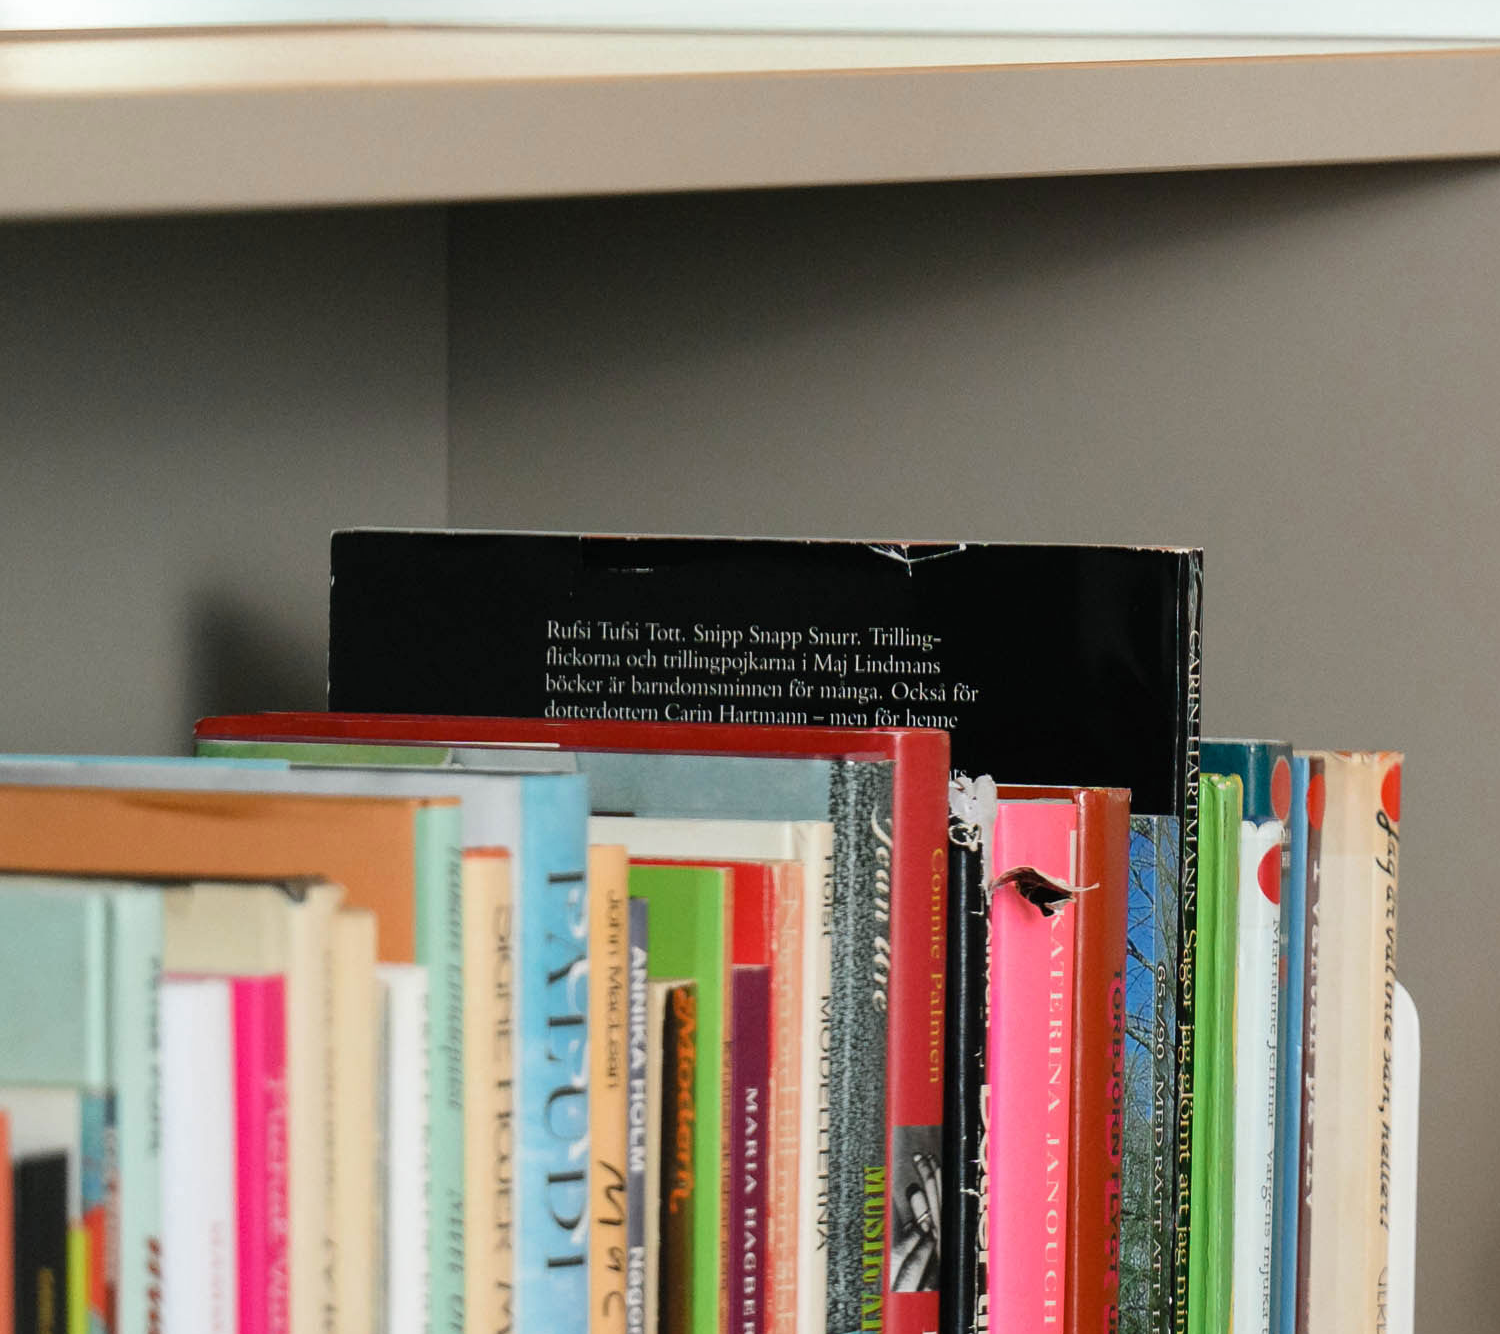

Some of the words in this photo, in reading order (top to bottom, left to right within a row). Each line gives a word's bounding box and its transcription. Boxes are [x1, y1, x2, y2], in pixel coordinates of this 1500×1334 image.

[546, 646, 621, 668] flickorna
[626, 648, 656, 668] och
[663, 648, 796, 675] trillingpojkarna
[802, 654, 808, 672] i
[813, 653, 847, 677] Maj
[855, 654, 941, 675] Lindmans
[547, 620, 591, 641] Rufsi
[598, 621, 640, 642] Tufsi
[645, 622, 686, 643] Tott.
[694, 623, 743, 648] Snipp
[750, 625, 802, 650] Snapp
[809, 625, 861, 647] Snurr.
[870, 626, 941, 651] Trilling-
[1188, 628, 1201, 723] CARIN
[544, 701, 658, 722] dotterdottern
[665, 703, 713, 724] Carin
[720, 704, 808, 726] Hartmann
[830, 710, 868, 727] men
[875, 705, 901, 728] för
[906, 707, 958, 730] henne
[545, 673, 602, 694] böcker
[608, 676, 626, 696] är
[631, 674, 782, 698] barndomsminnen
[788, 677, 814, 699] för
[820, 681, 883, 704] många.
[891, 681, 947, 702] Också
[953, 682, 979, 703] för
[1184, 735, 1200, 913] HARTMANN
[1375, 810, 1400, 878] Jag
[930, 848, 945, 959] Connie
[630, 946, 648, 1069] ANNIKA
[1047, 907, 1065, 1115] KATERINA
[1182, 929, 1196, 1013] Sagor
[928, 973, 944, 1083] Palmen
[1111, 967, 1123, 1157] TORBJÖRN
[1178, 1024, 1194, 1062] jag
[630, 1077, 647, 1175] HOLM
[744, 1087, 758, 1194] MARIA
[1154, 1079, 1165, 1146] MED
[1179, 1073, 1194, 1163] glömt
[978, 1083, 993, 1273] Dotter
[1152, 1155, 1164, 1233] RÄTT
[1178, 1172, 1190, 1215] att
[1043, 1131, 1060, 1325] JANOUCH
[1109, 1172, 1120, 1277] FLYGT
[1151, 1238, 1162, 1295] ATT
[1175, 1226, 1190, 1266] jag
